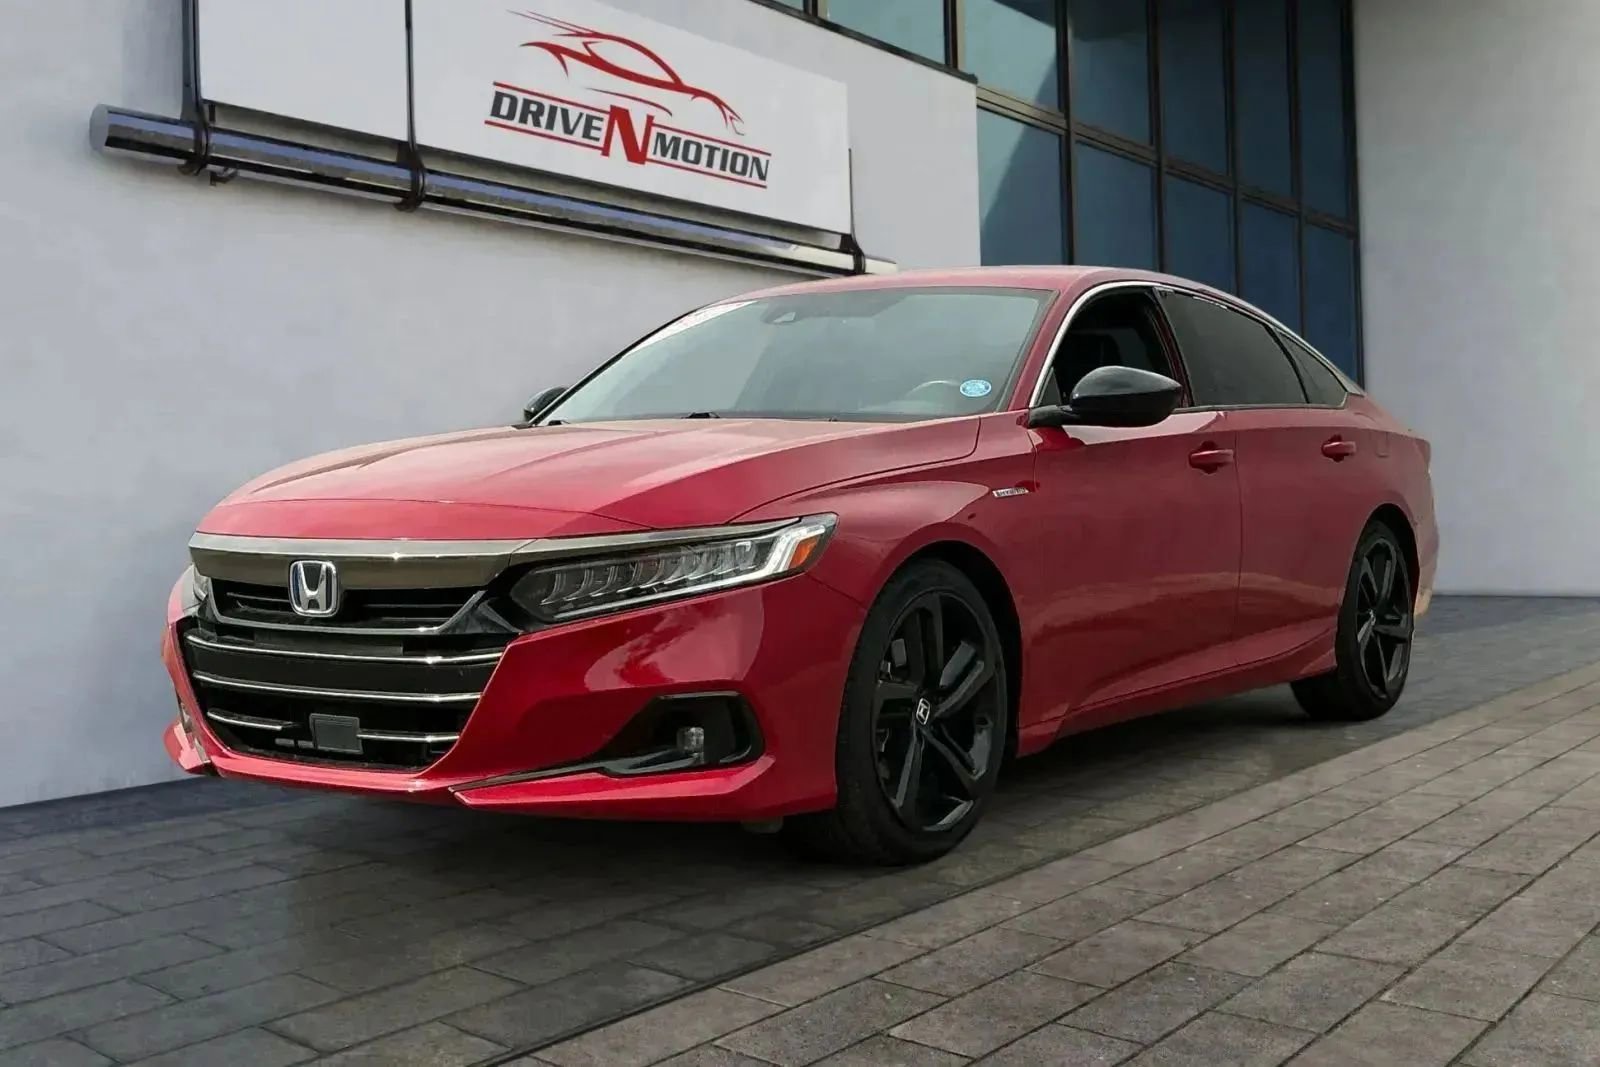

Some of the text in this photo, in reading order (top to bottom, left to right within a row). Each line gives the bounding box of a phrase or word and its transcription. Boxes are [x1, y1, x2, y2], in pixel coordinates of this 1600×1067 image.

[490, 90, 770, 181] DRIVE N MOTION
